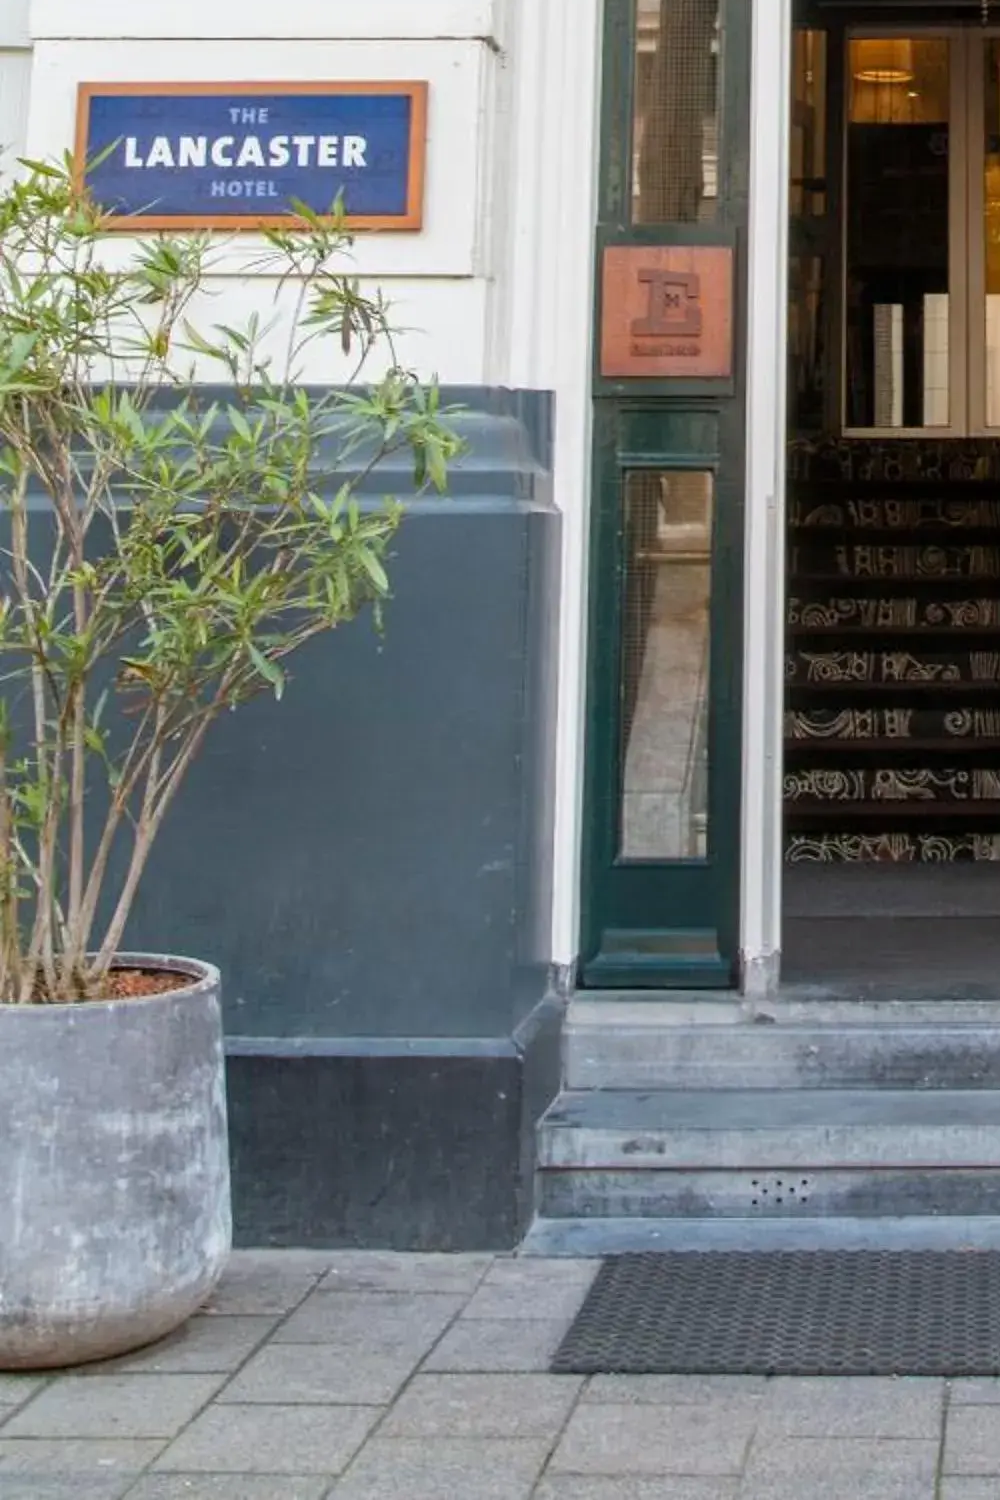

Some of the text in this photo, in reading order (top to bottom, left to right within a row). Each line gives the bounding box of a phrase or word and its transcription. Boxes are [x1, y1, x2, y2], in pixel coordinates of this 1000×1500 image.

[229, 107, 269, 125] THE
[124, 135, 367, 168] LANCASTER
[210, 180, 278, 197] HOTEL
